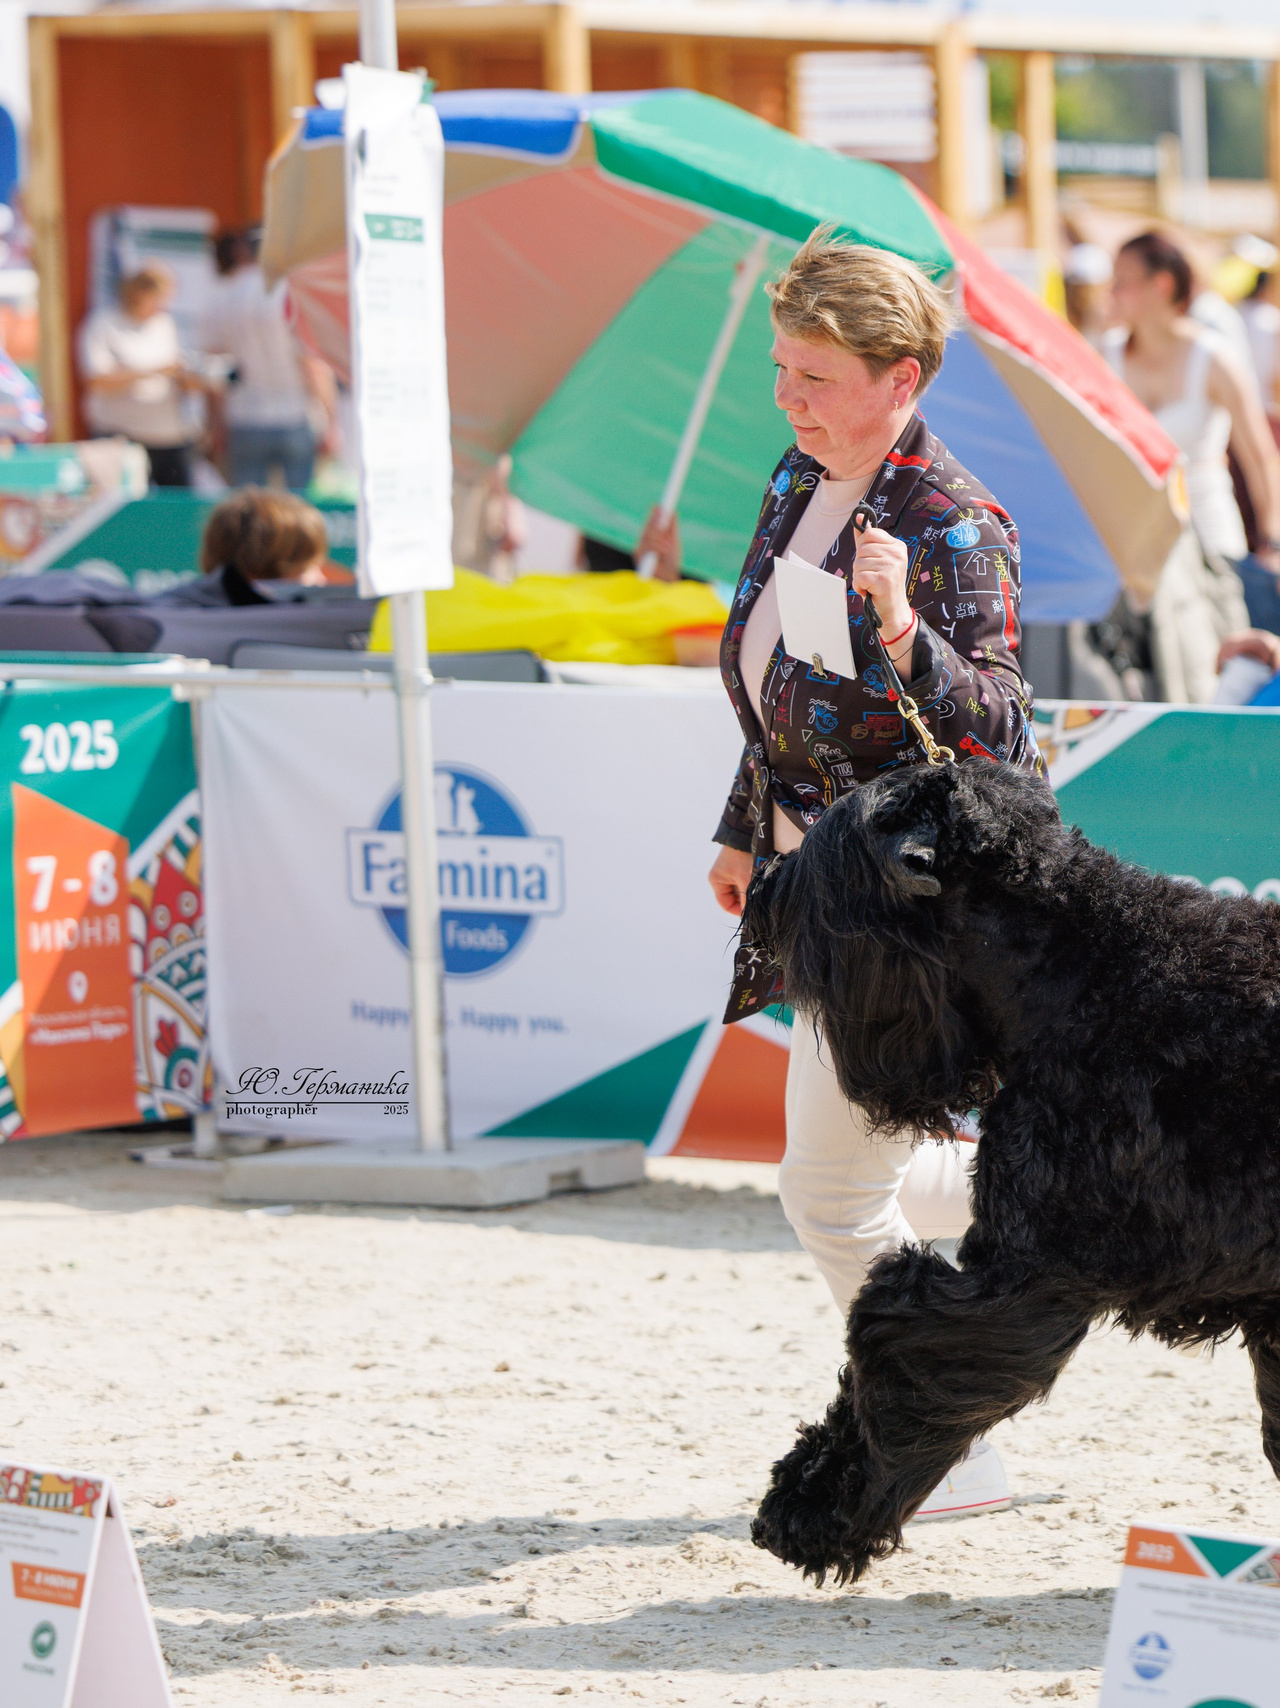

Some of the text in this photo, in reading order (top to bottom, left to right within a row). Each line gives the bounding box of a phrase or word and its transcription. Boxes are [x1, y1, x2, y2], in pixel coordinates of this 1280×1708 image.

[19, 719, 119, 774] 2025
[362, 842, 549, 902] Famina
[445, 918, 509, 954] Foods
[351, 1000, 569, 1036] Happy Happy you.
